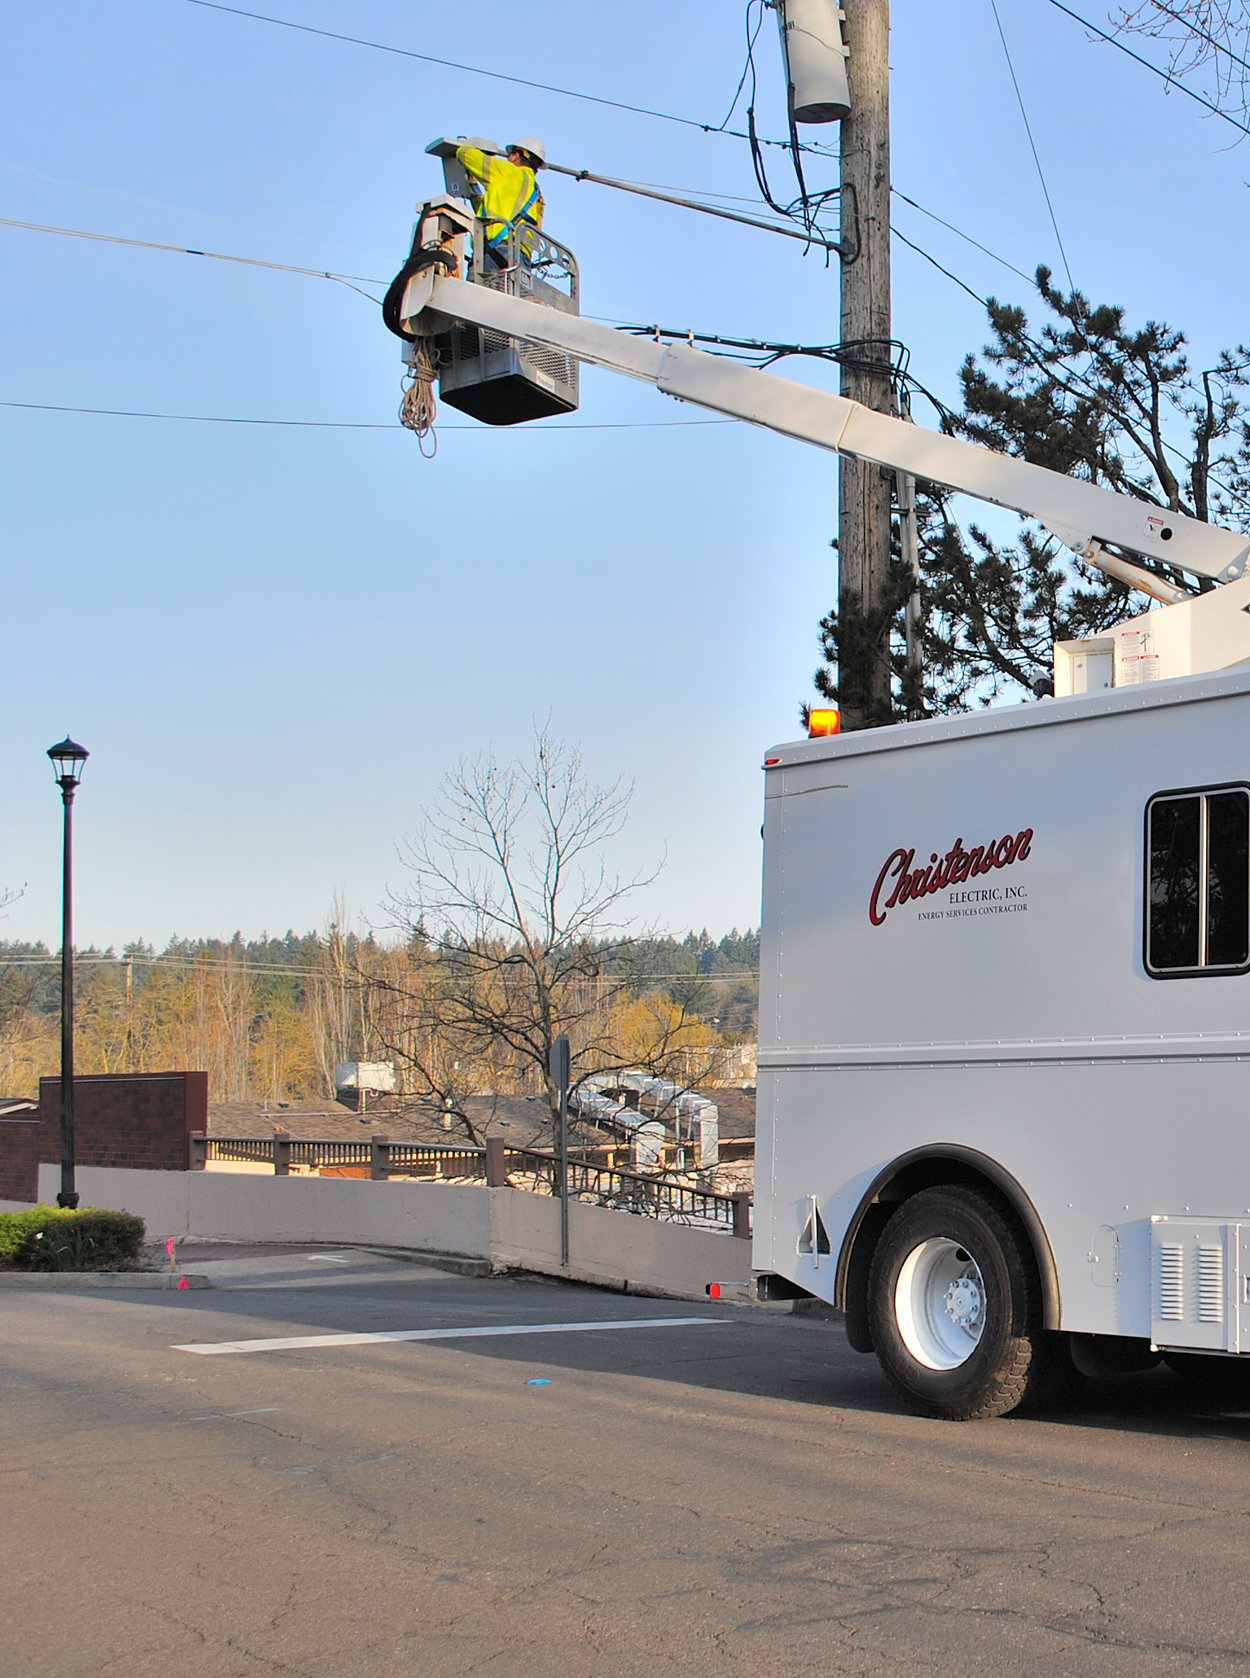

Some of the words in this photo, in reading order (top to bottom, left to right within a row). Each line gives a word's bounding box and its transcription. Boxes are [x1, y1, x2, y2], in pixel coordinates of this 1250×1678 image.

[869, 828, 1034, 926] Christenson
[949, 888, 1002, 904] ELECTRIC,
[1005, 886, 1028, 899] INC.
[918, 909, 945, 920] ENERGY
[945, 907, 978, 918] SERVICES
[978, 903, 1028, 915] CONTRACTOR
